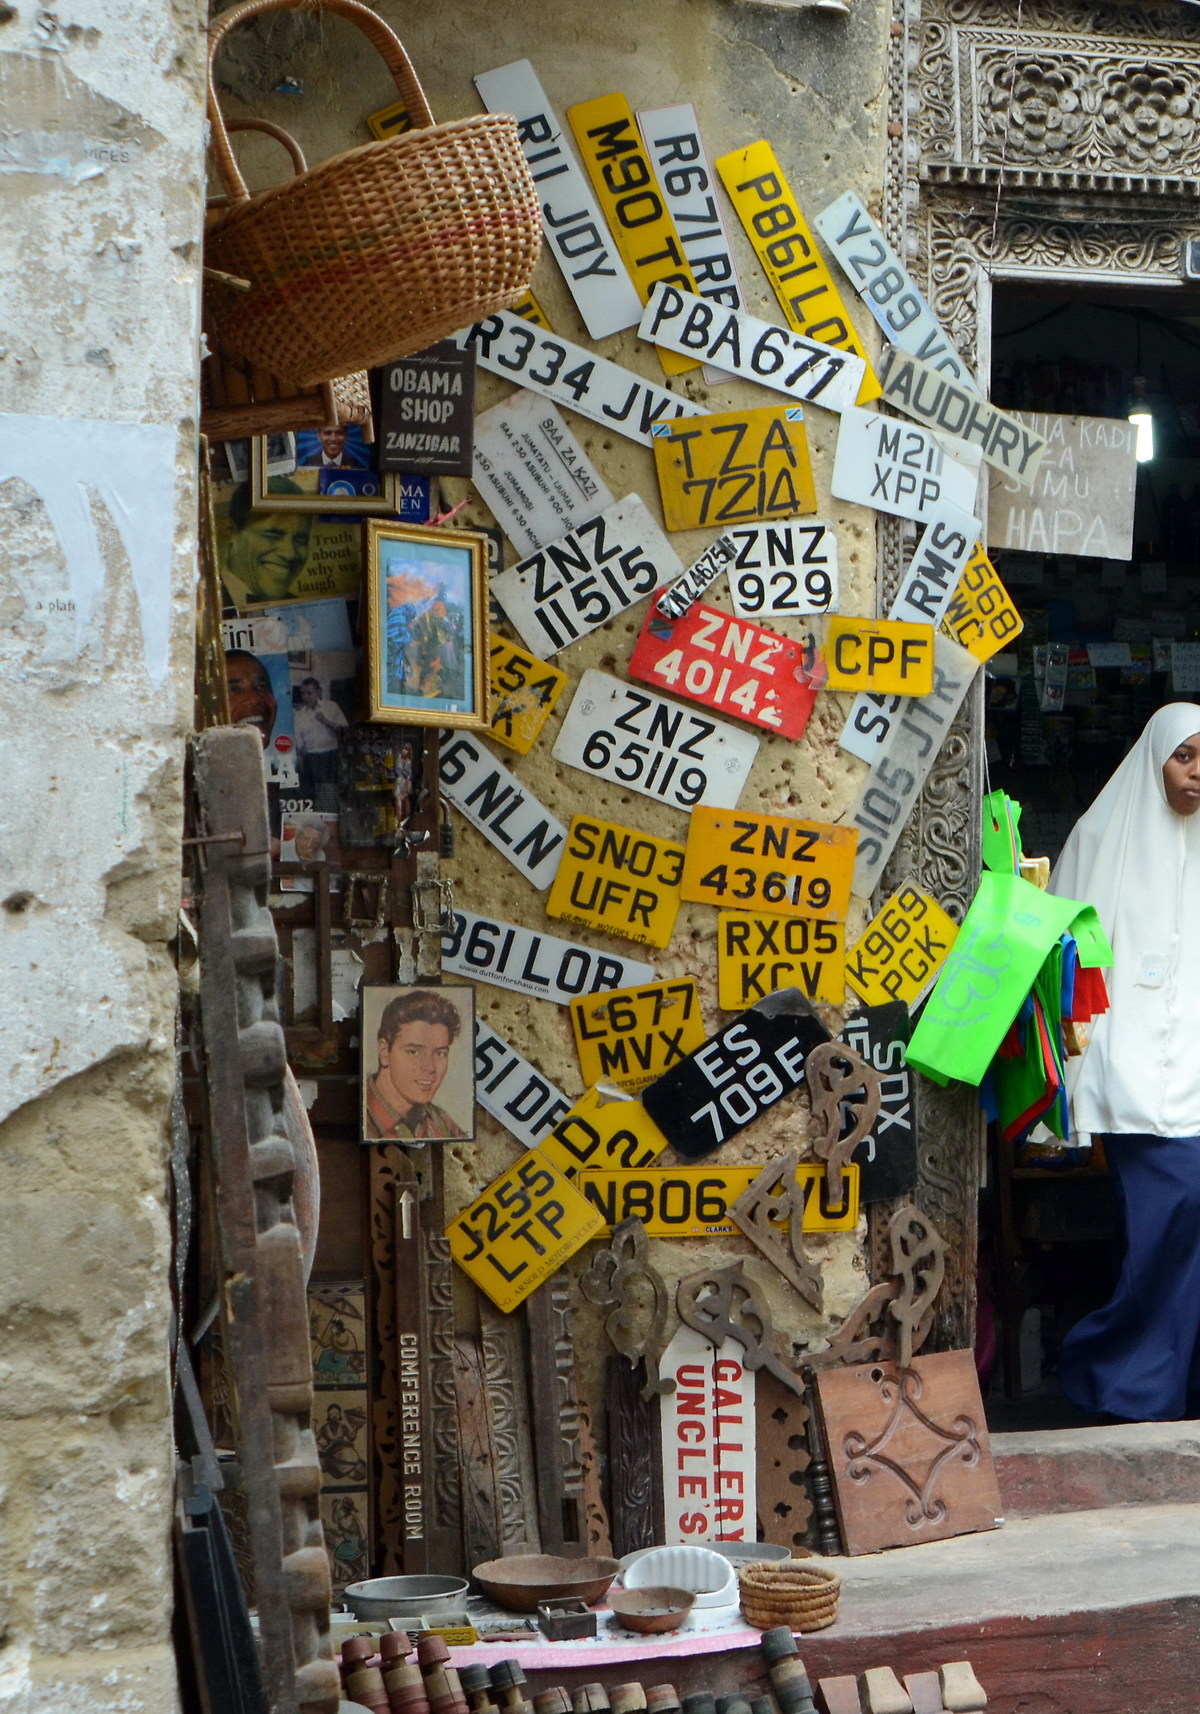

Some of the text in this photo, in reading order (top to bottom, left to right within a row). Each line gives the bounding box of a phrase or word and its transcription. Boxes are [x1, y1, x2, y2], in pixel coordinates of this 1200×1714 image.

[835, 209, 922, 332] Y289
[464, 314, 596, 402] R334
[650, 286, 844, 400] PBA671
[390, 368, 462, 396] OBAMA
[401, 398, 454, 424] SHOP
[385, 432, 461, 453] ZANZIBAR
[561, 447, 577, 466] ZA
[667, 418, 798, 478] TZA
[870, 463, 941, 512] XPP
[312, 549, 351, 562] about
[313, 533, 354, 547] Truth
[515, 514, 623, 604] ZNZ
[732, 525, 828, 571] ZNZ
[1006, 506, 1109, 554] HAPA
[307, 563, 336, 577] why
[736, 569, 833, 613] 929
[905, 521, 967, 618] RMS
[690, 609, 784, 676] ZNZ
[834, 632, 928, 679] CPF
[614, 690, 716, 762] ZNZ
[464, 770, 563, 870] NLN
[730, 821, 820, 863] ZNZ
[569, 871, 658, 928] UFR
[699, 864, 832, 909] 43619
[595, 922, 631, 938] MOTORS
[845, 886, 928, 989] K969
[880, 924, 947, 1000] PGK
[575, 982, 696, 1041] L677
[597, 1028, 689, 1076] MVX
[692, 1022, 762, 1090] ES
[458, 1159, 555, 1262] J255
[486, 1200, 565, 1283] LTP
[514, 1266, 545, 1296] ARNOLD
[545, 1218, 600, 1267] MOTORCYCLES
[710, 1358, 745, 1543] GALLERY
[402, 1482, 424, 1542] ROOM
